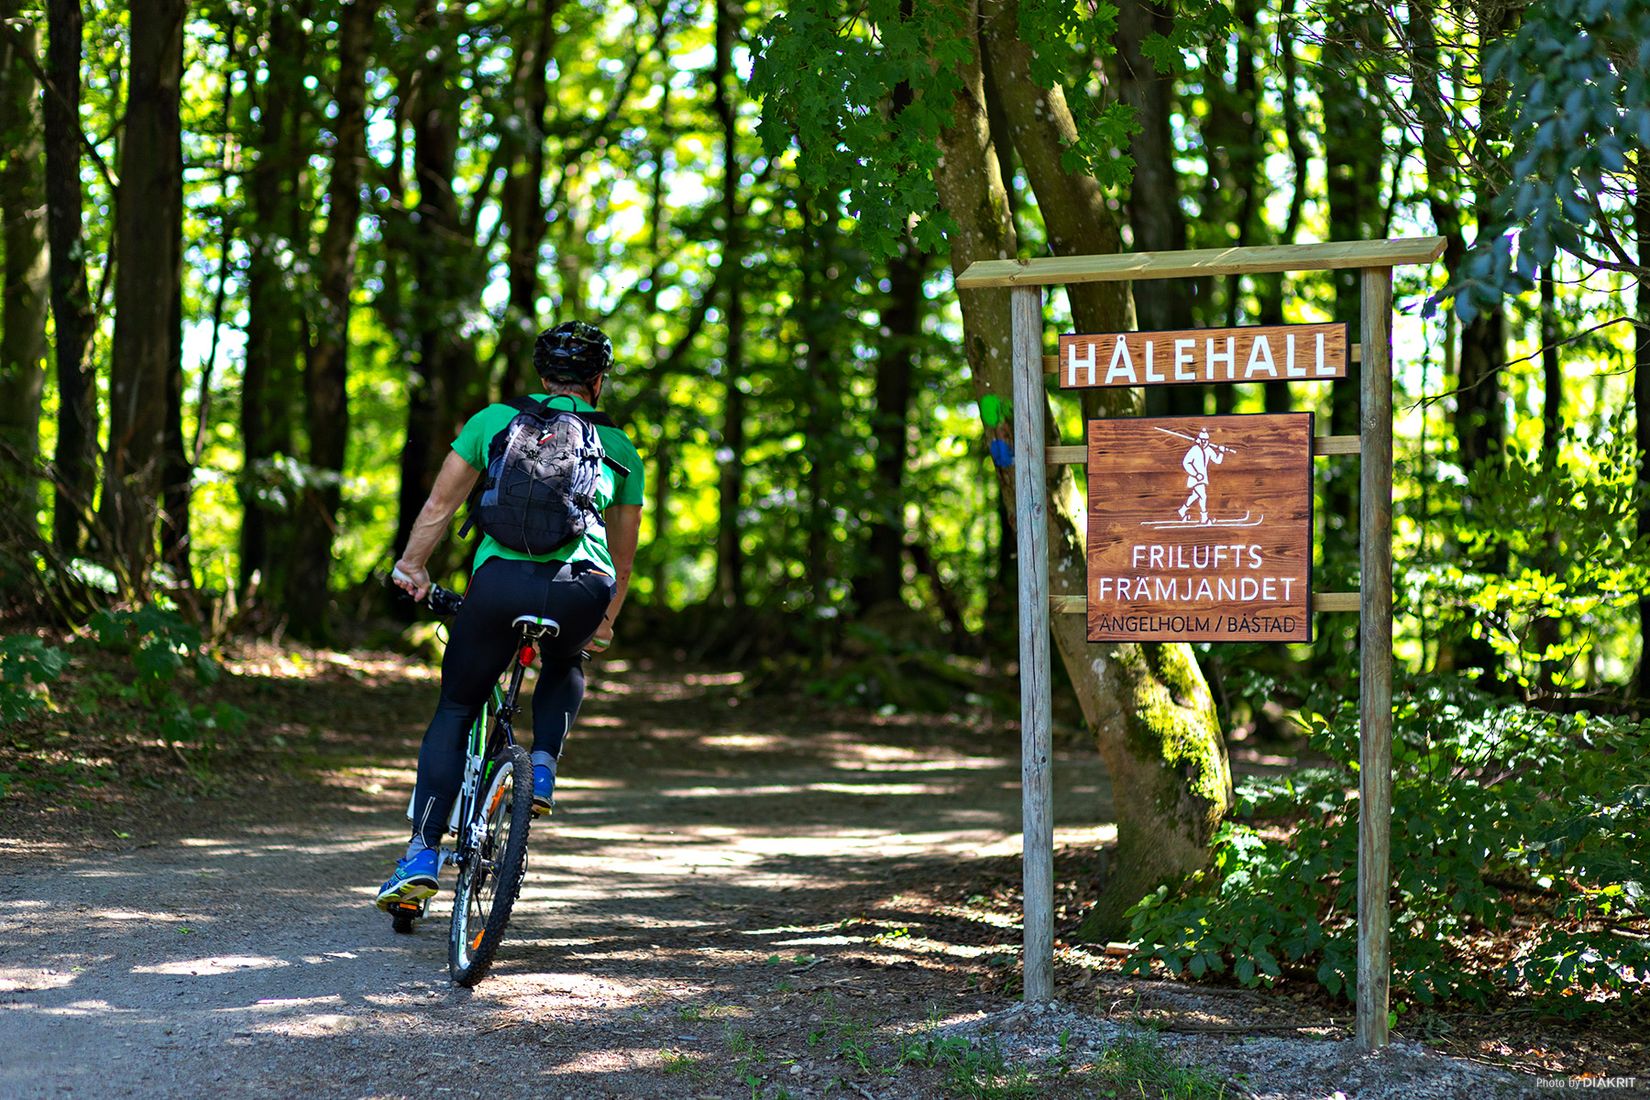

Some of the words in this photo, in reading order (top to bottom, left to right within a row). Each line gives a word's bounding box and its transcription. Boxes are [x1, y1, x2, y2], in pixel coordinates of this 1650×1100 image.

[1068, 333, 1336, 386] HÅLEHALL
[1132, 544, 1263, 568] FRILUFTS
[1099, 576, 1296, 601] FRÄMJANDET
[1099, 614, 1210, 632] ÄNGELHOLM
[1227, 613, 1296, 633] BÅSTAD
